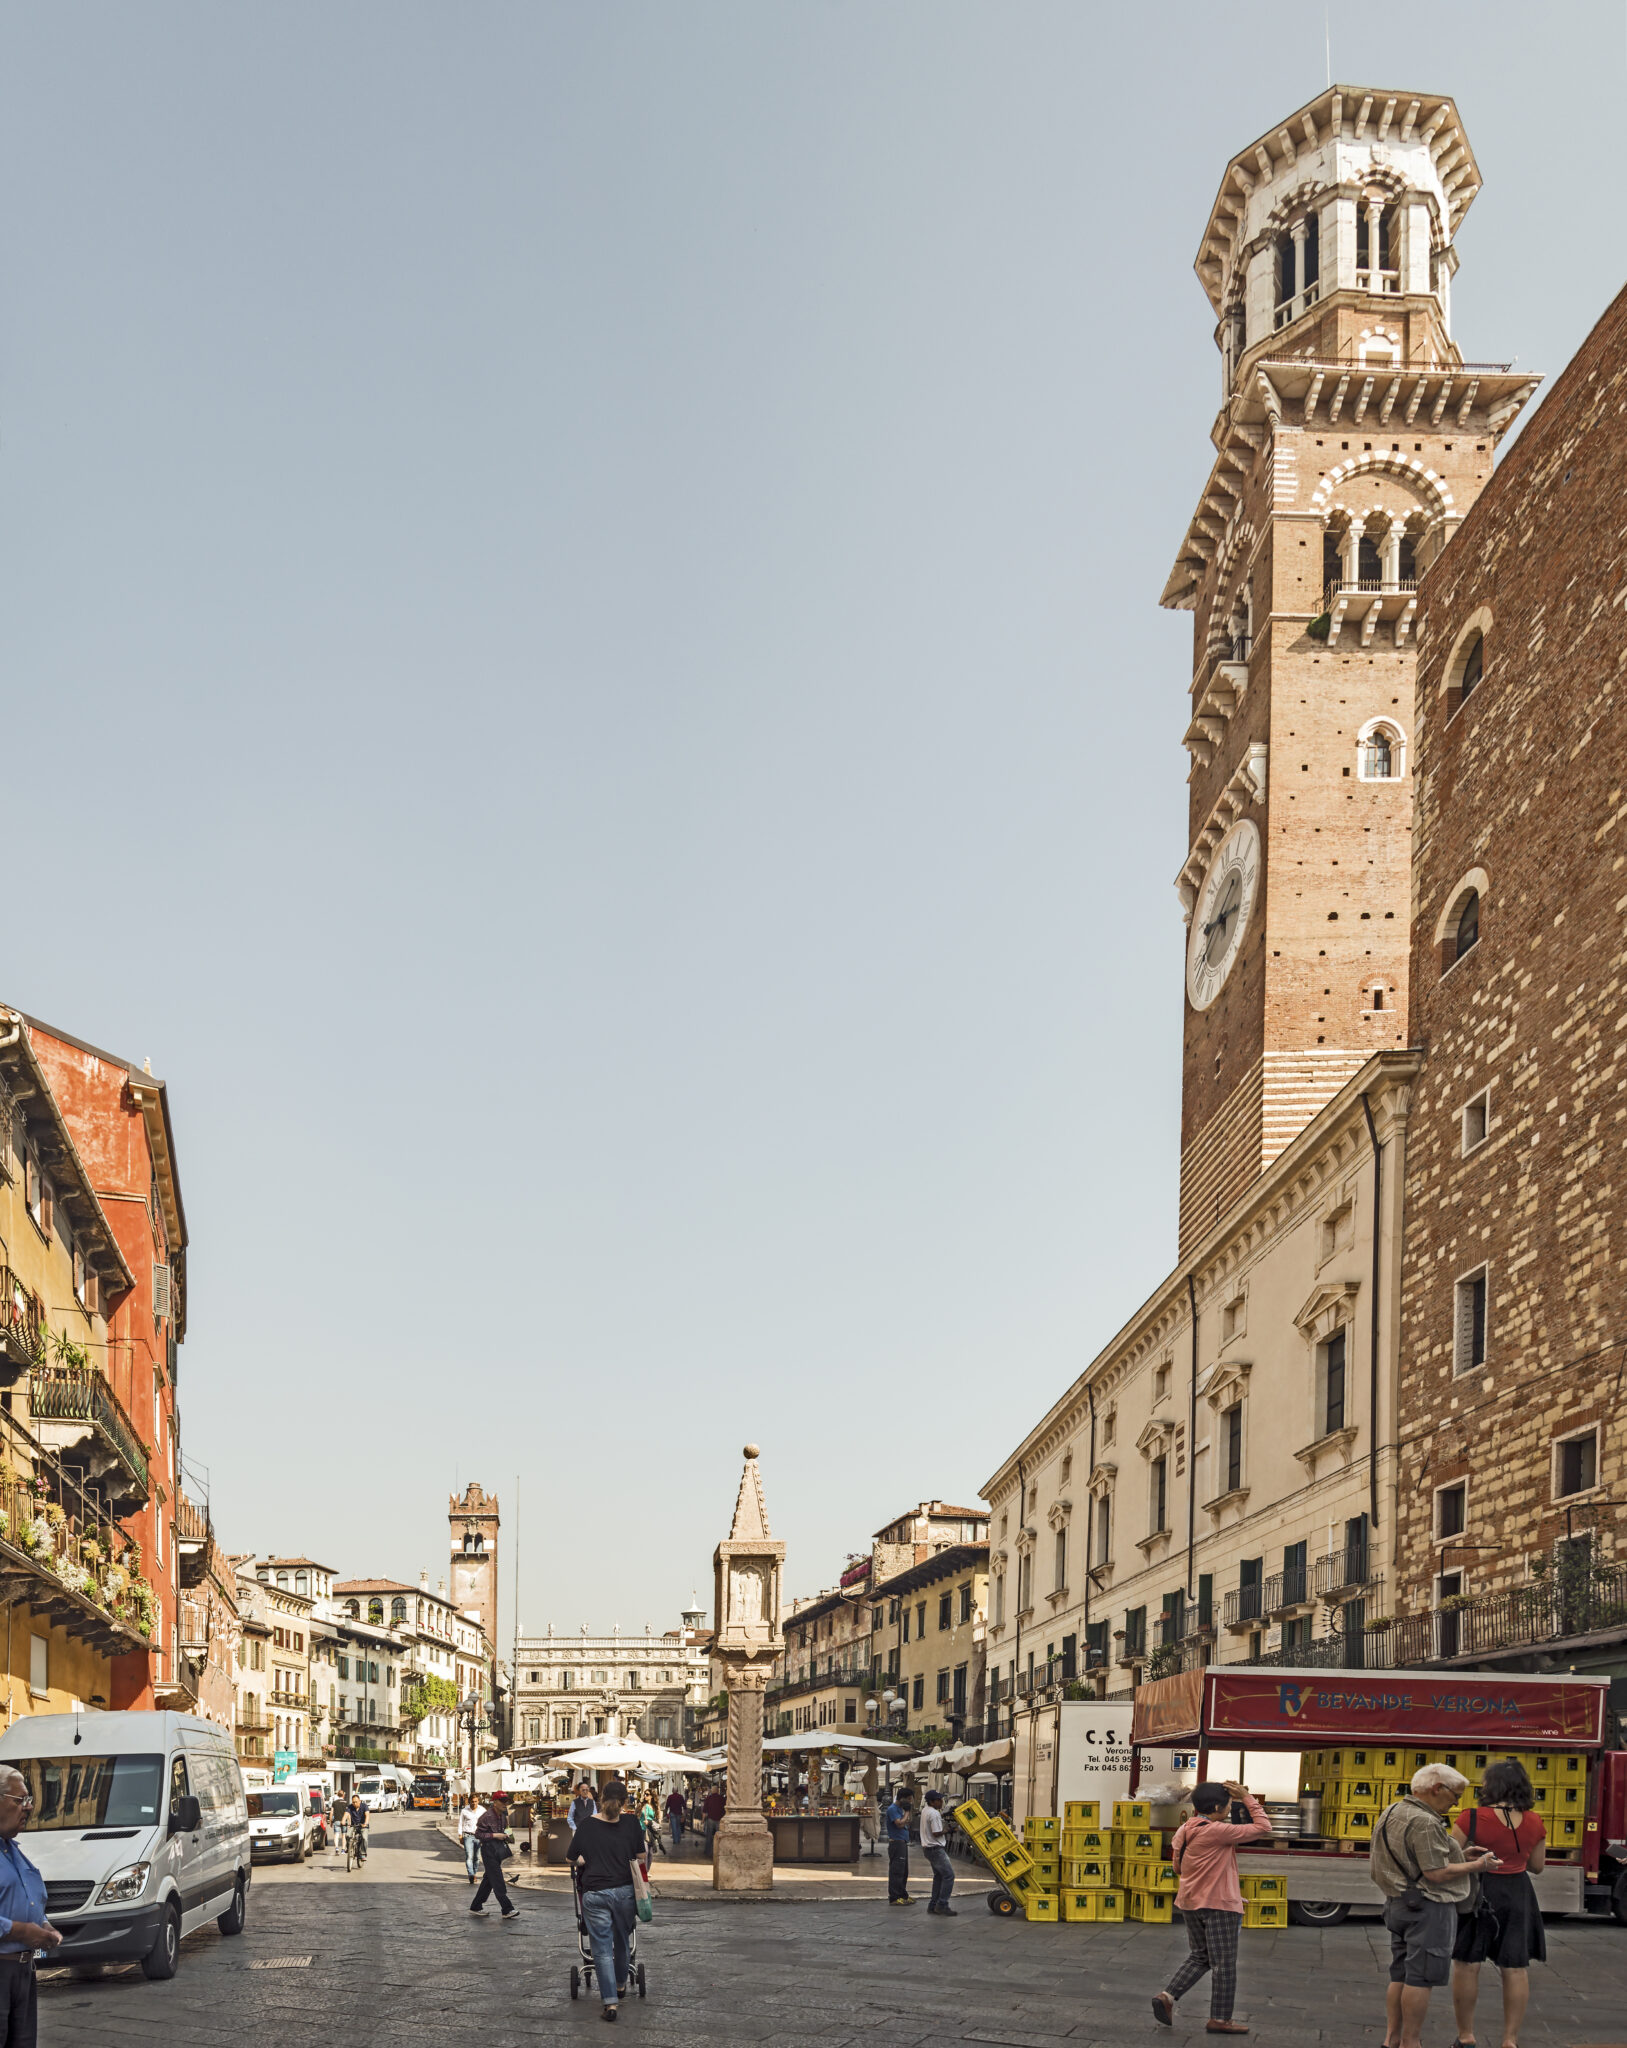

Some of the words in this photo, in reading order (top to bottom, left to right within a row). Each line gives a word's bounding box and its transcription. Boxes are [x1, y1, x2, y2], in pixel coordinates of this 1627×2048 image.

[1317, 1691, 1414, 1711] BEVANDE
[1431, 1694, 1521, 1714] VERONA
[1088, 1755, 1101, 1763] Tel.
[1104, 1755, 1120, 1763] 045
